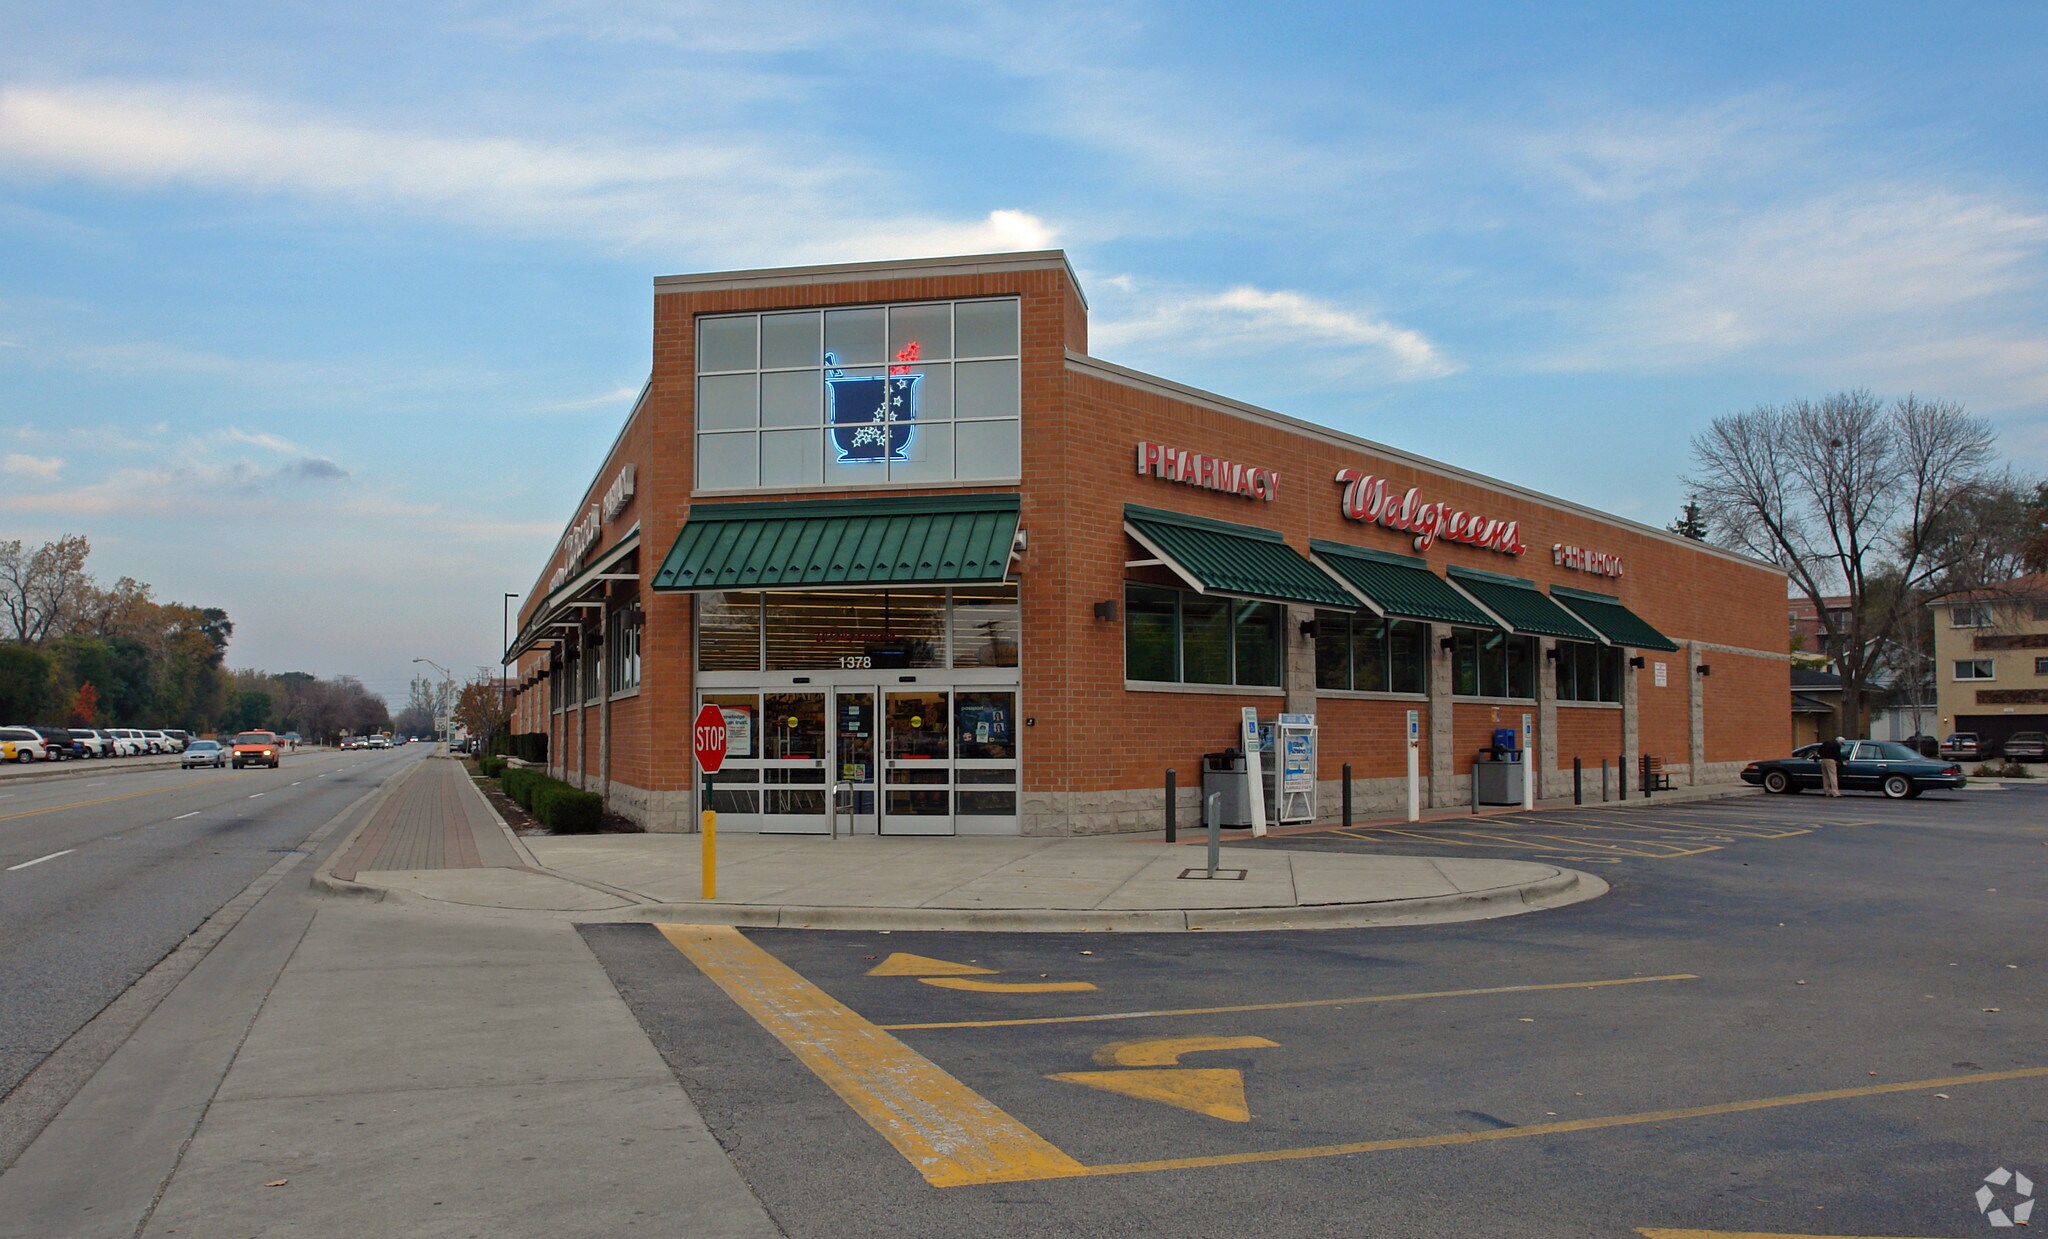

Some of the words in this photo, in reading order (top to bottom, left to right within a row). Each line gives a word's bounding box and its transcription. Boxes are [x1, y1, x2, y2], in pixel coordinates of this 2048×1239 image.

[1138, 441, 1281, 501] PHARMACY
[1335, 468, 1527, 556] Walgreens
[1553, 543, 1586, 570] 1-HR
[1586, 551, 1624, 578] PHOTO
[839, 656, 872, 669] 1378
[696, 726, 726, 751] STOP
